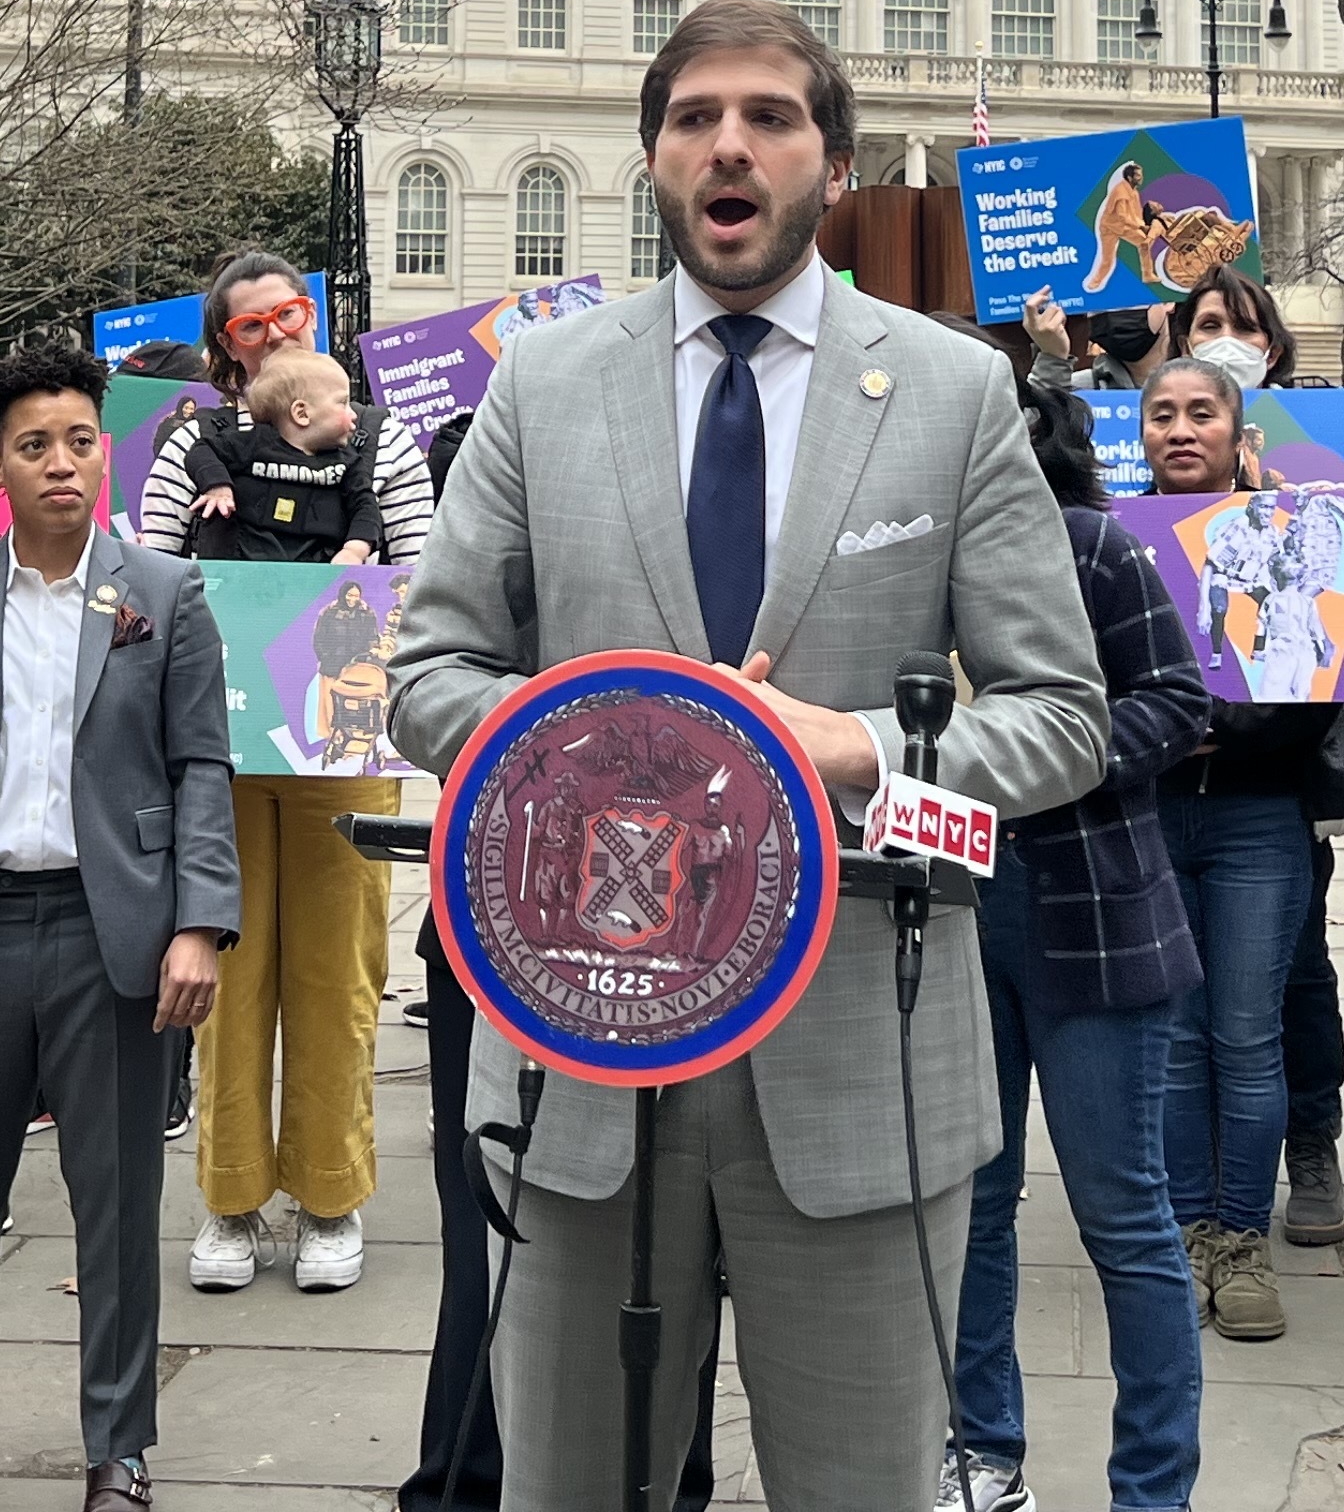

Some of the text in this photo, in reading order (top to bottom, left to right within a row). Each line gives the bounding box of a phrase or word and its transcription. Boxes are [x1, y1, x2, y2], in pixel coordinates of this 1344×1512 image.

[975, 187, 1057, 211] Working
[978, 209, 1054, 232] Families
[981, 230, 1058, 253] Deserve
[983, 246, 1078, 273] the Credit
[378, 348, 465, 384] Immigrant
[383, 377, 450, 405] Families
[388, 394, 455, 421] Deserve
[1092, 439, 1146, 461] orki
[252, 461, 346, 486] RAMONES
[893, 800, 989, 853] WNYC
[660, 970, 725, 1021] NOVI
[729, 848, 781, 972] EBORACI
[588, 970, 653, 996] 1625
